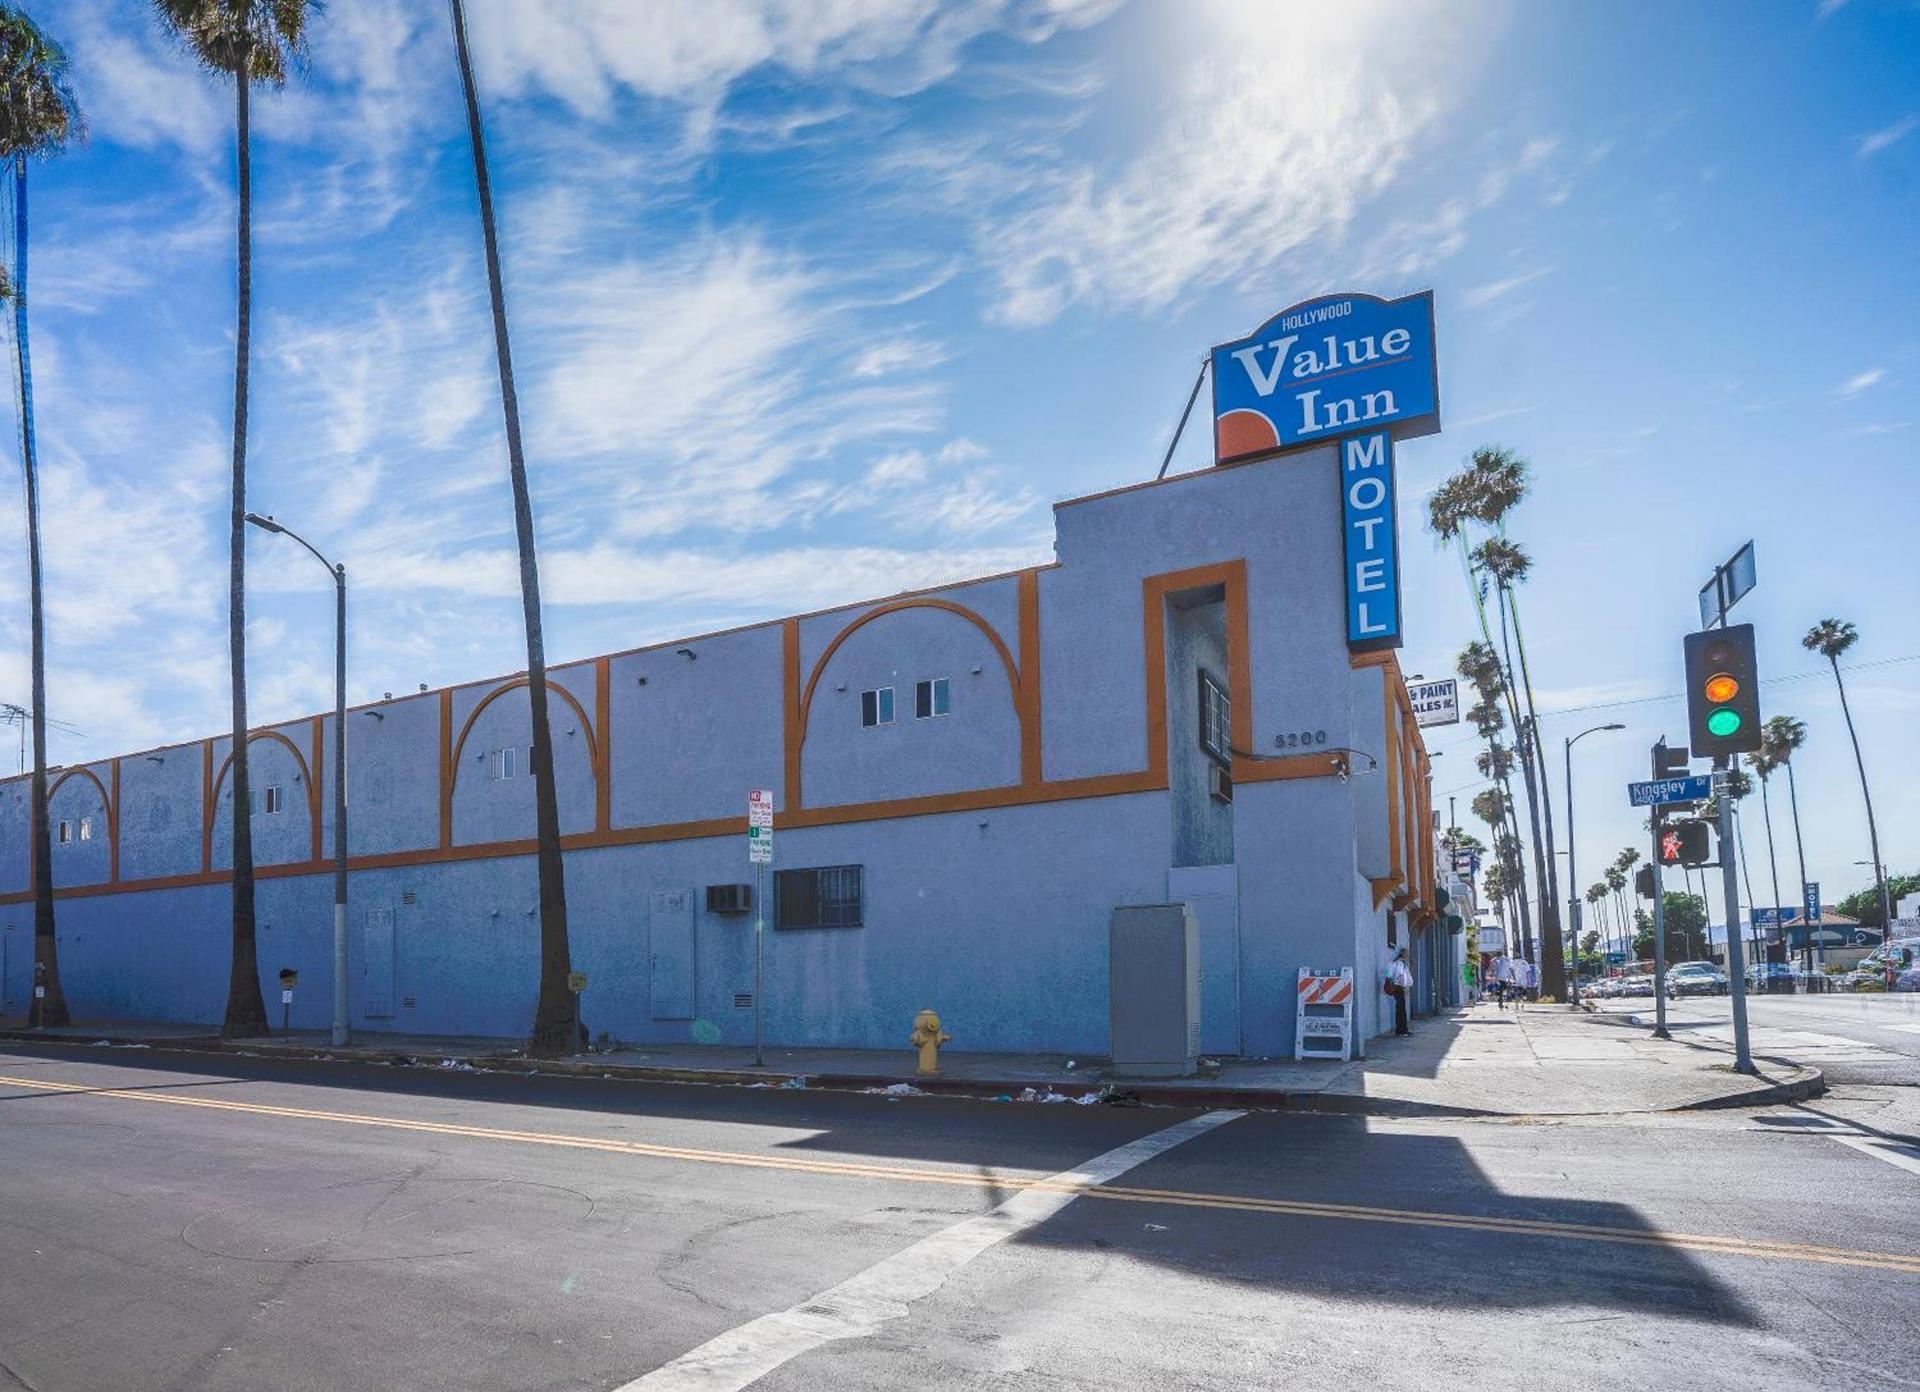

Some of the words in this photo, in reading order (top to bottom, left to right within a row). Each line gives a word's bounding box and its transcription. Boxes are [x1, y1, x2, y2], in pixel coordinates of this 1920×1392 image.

[1282, 302, 1352, 332] HOLLYWOOD
[1231, 328, 1411, 397] Value
[1296, 389, 1400, 435] Inn
[1347, 435, 1387, 634] MOTEL
[1420, 683, 1453, 700] PAINT
[1275, 730, 1326, 747] 5200
[1633, 781, 1686, 798] Kingsley
[1808, 889, 1816, 919] MOTEL
